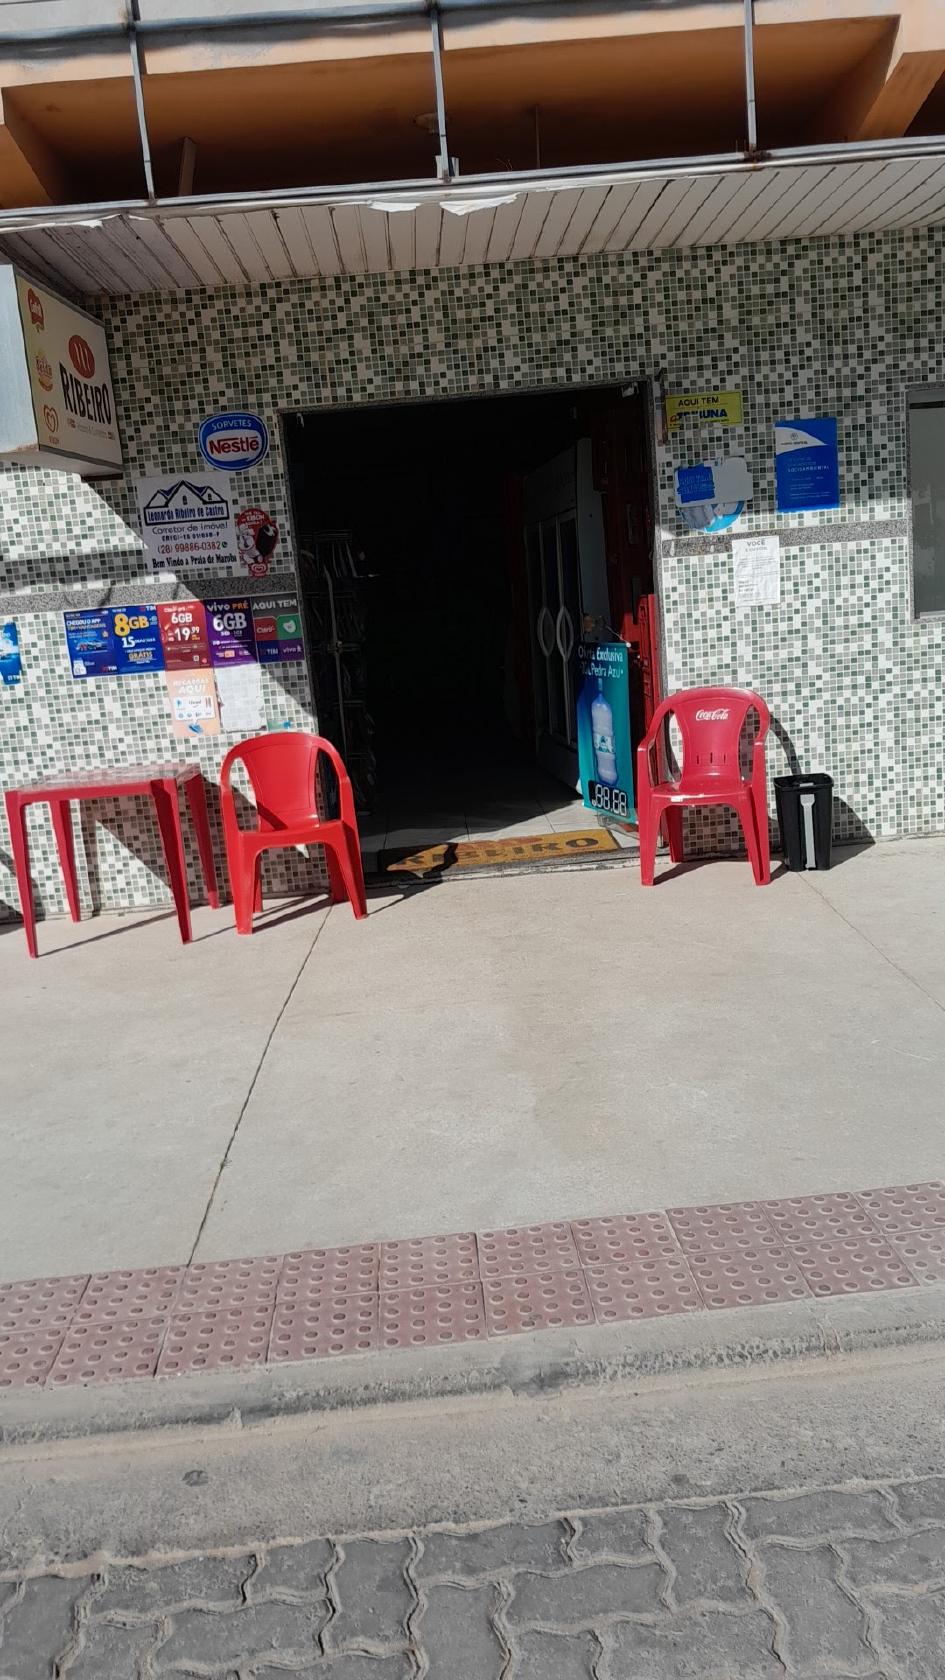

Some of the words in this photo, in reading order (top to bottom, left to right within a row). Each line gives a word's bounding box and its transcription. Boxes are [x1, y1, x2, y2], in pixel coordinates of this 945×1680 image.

[59, 361, 112, 425] RIBEIRO
[678, 398, 699, 407] AQUI
[701, 396, 719, 405] TEM
[211, 419, 252, 431] SORVETES
[208, 436, 260, 455] Nestlé
[197, 507, 204, 517] de
[205, 505, 225, 517] Castro
[152, 524, 185, 535] Corretor
[187, 522, 199, 532] de
[152, 557, 165, 569] Bem
[167, 556, 184, 567] Vindo
[190, 555, 207, 565] Praia
[207, 554, 215, 564] de
[207, 602, 230, 612] vivo
[252, 601, 276, 611] AQUI
[277, 599, 297, 608] TEM
[171, 612, 193, 624] 6GB
[213, 612, 247, 632] 6GB
[114, 613, 149, 637] 8GB
[122, 636, 136, 649] 15
[597, 647, 624, 662] Exclusiva
[178, 685, 206, 694] AQUI
[695, 708, 731, 721] Coca-Cola
